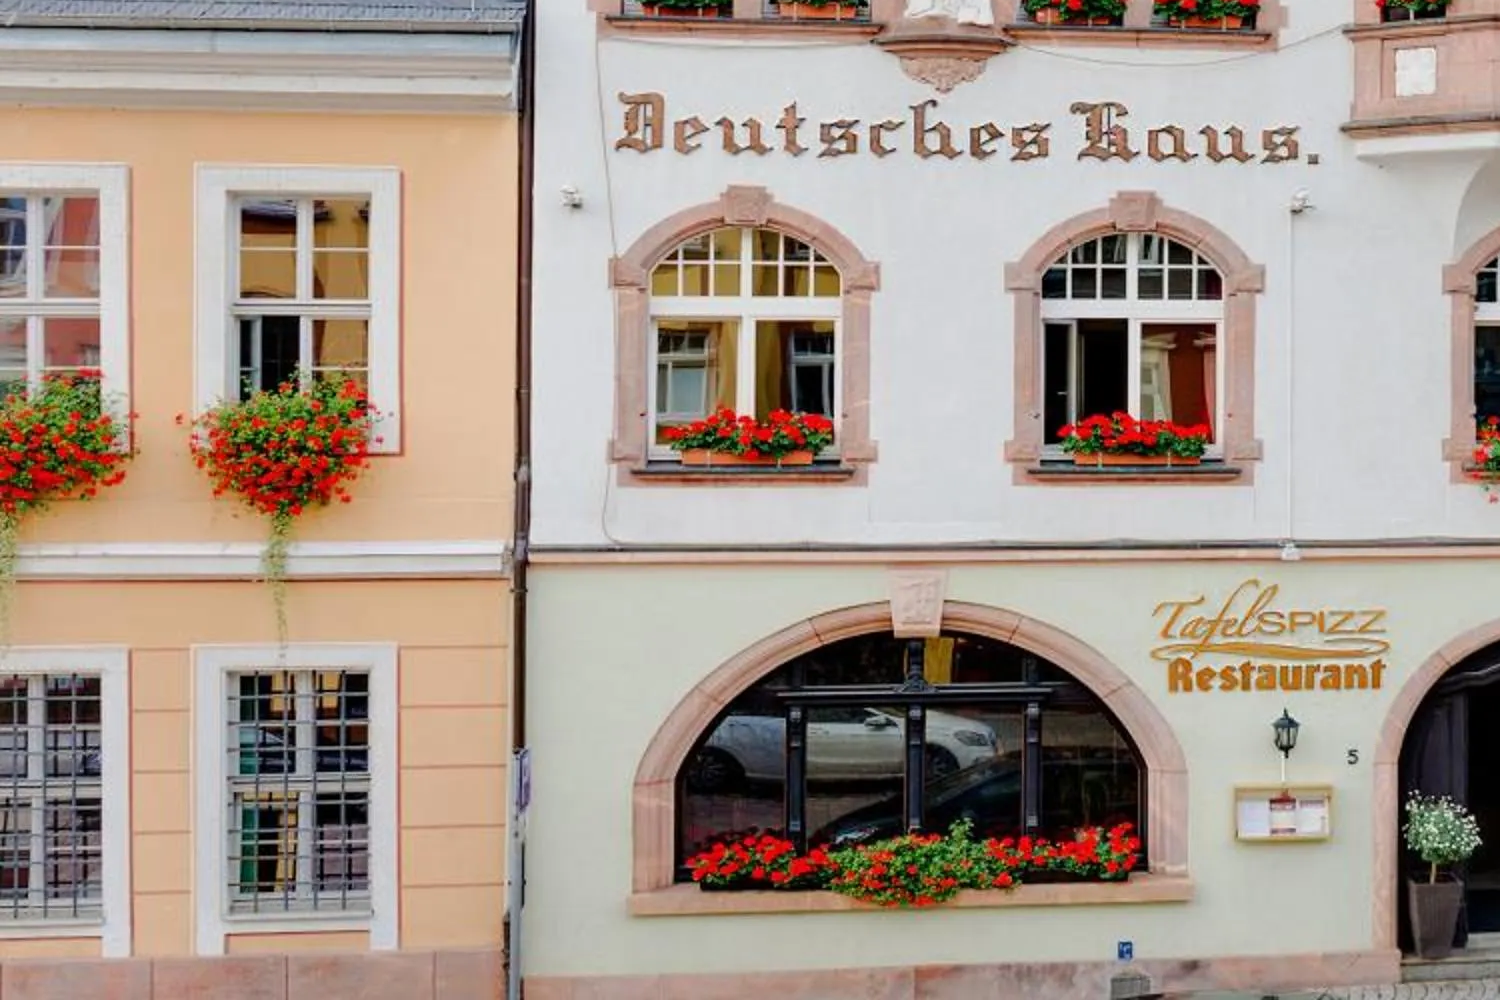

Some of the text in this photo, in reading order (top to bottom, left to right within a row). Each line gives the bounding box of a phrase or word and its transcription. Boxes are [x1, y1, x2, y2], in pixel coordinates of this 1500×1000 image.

[616, 91, 1053, 163] Deutsches
[1167, 657, 1386, 694] Restaurant
[1347, 749, 1359, 765] 5
